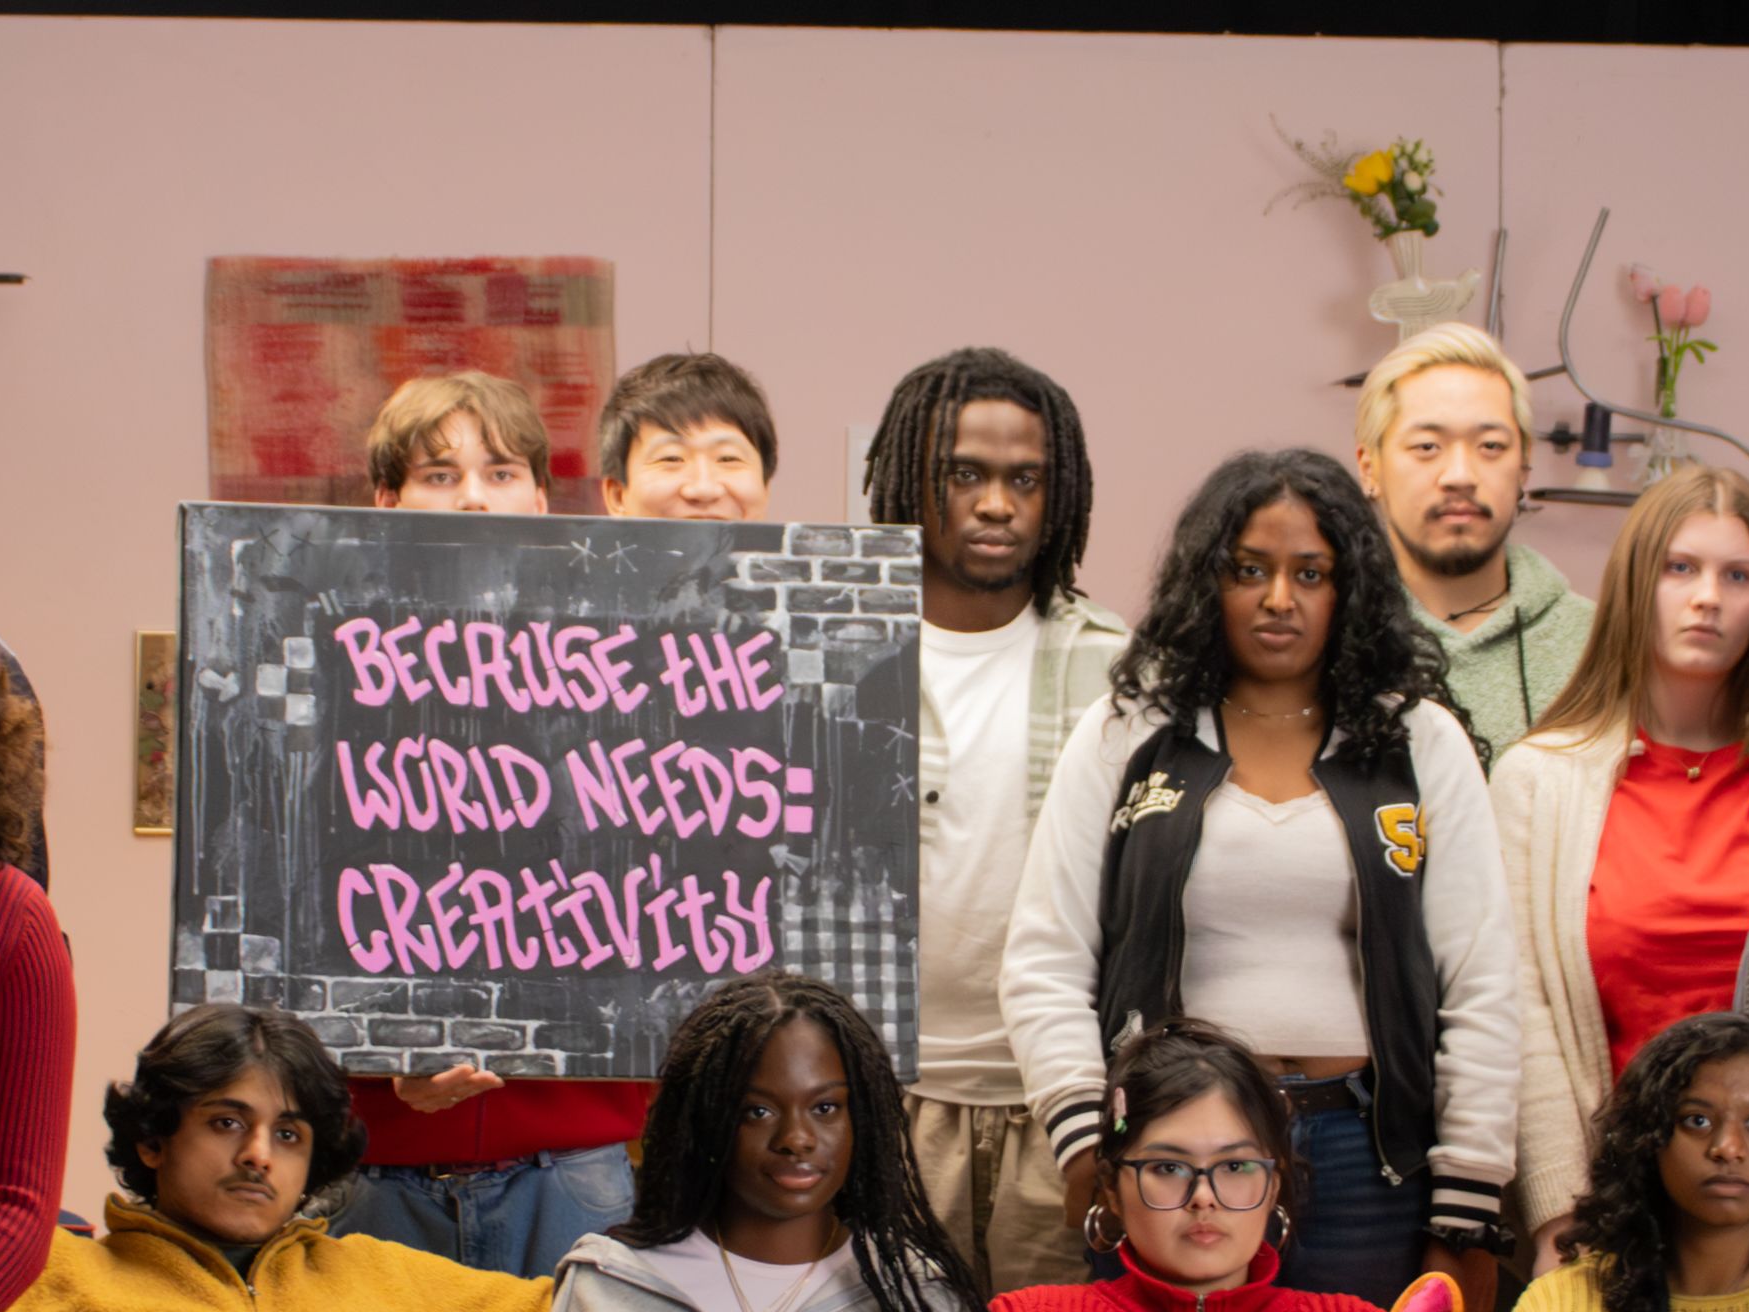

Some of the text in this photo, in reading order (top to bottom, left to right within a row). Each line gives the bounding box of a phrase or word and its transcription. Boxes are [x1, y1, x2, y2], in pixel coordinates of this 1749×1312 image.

[334, 616, 650, 714] BECAUSE
[336, 734, 814, 840] WORLD NEEDS:
